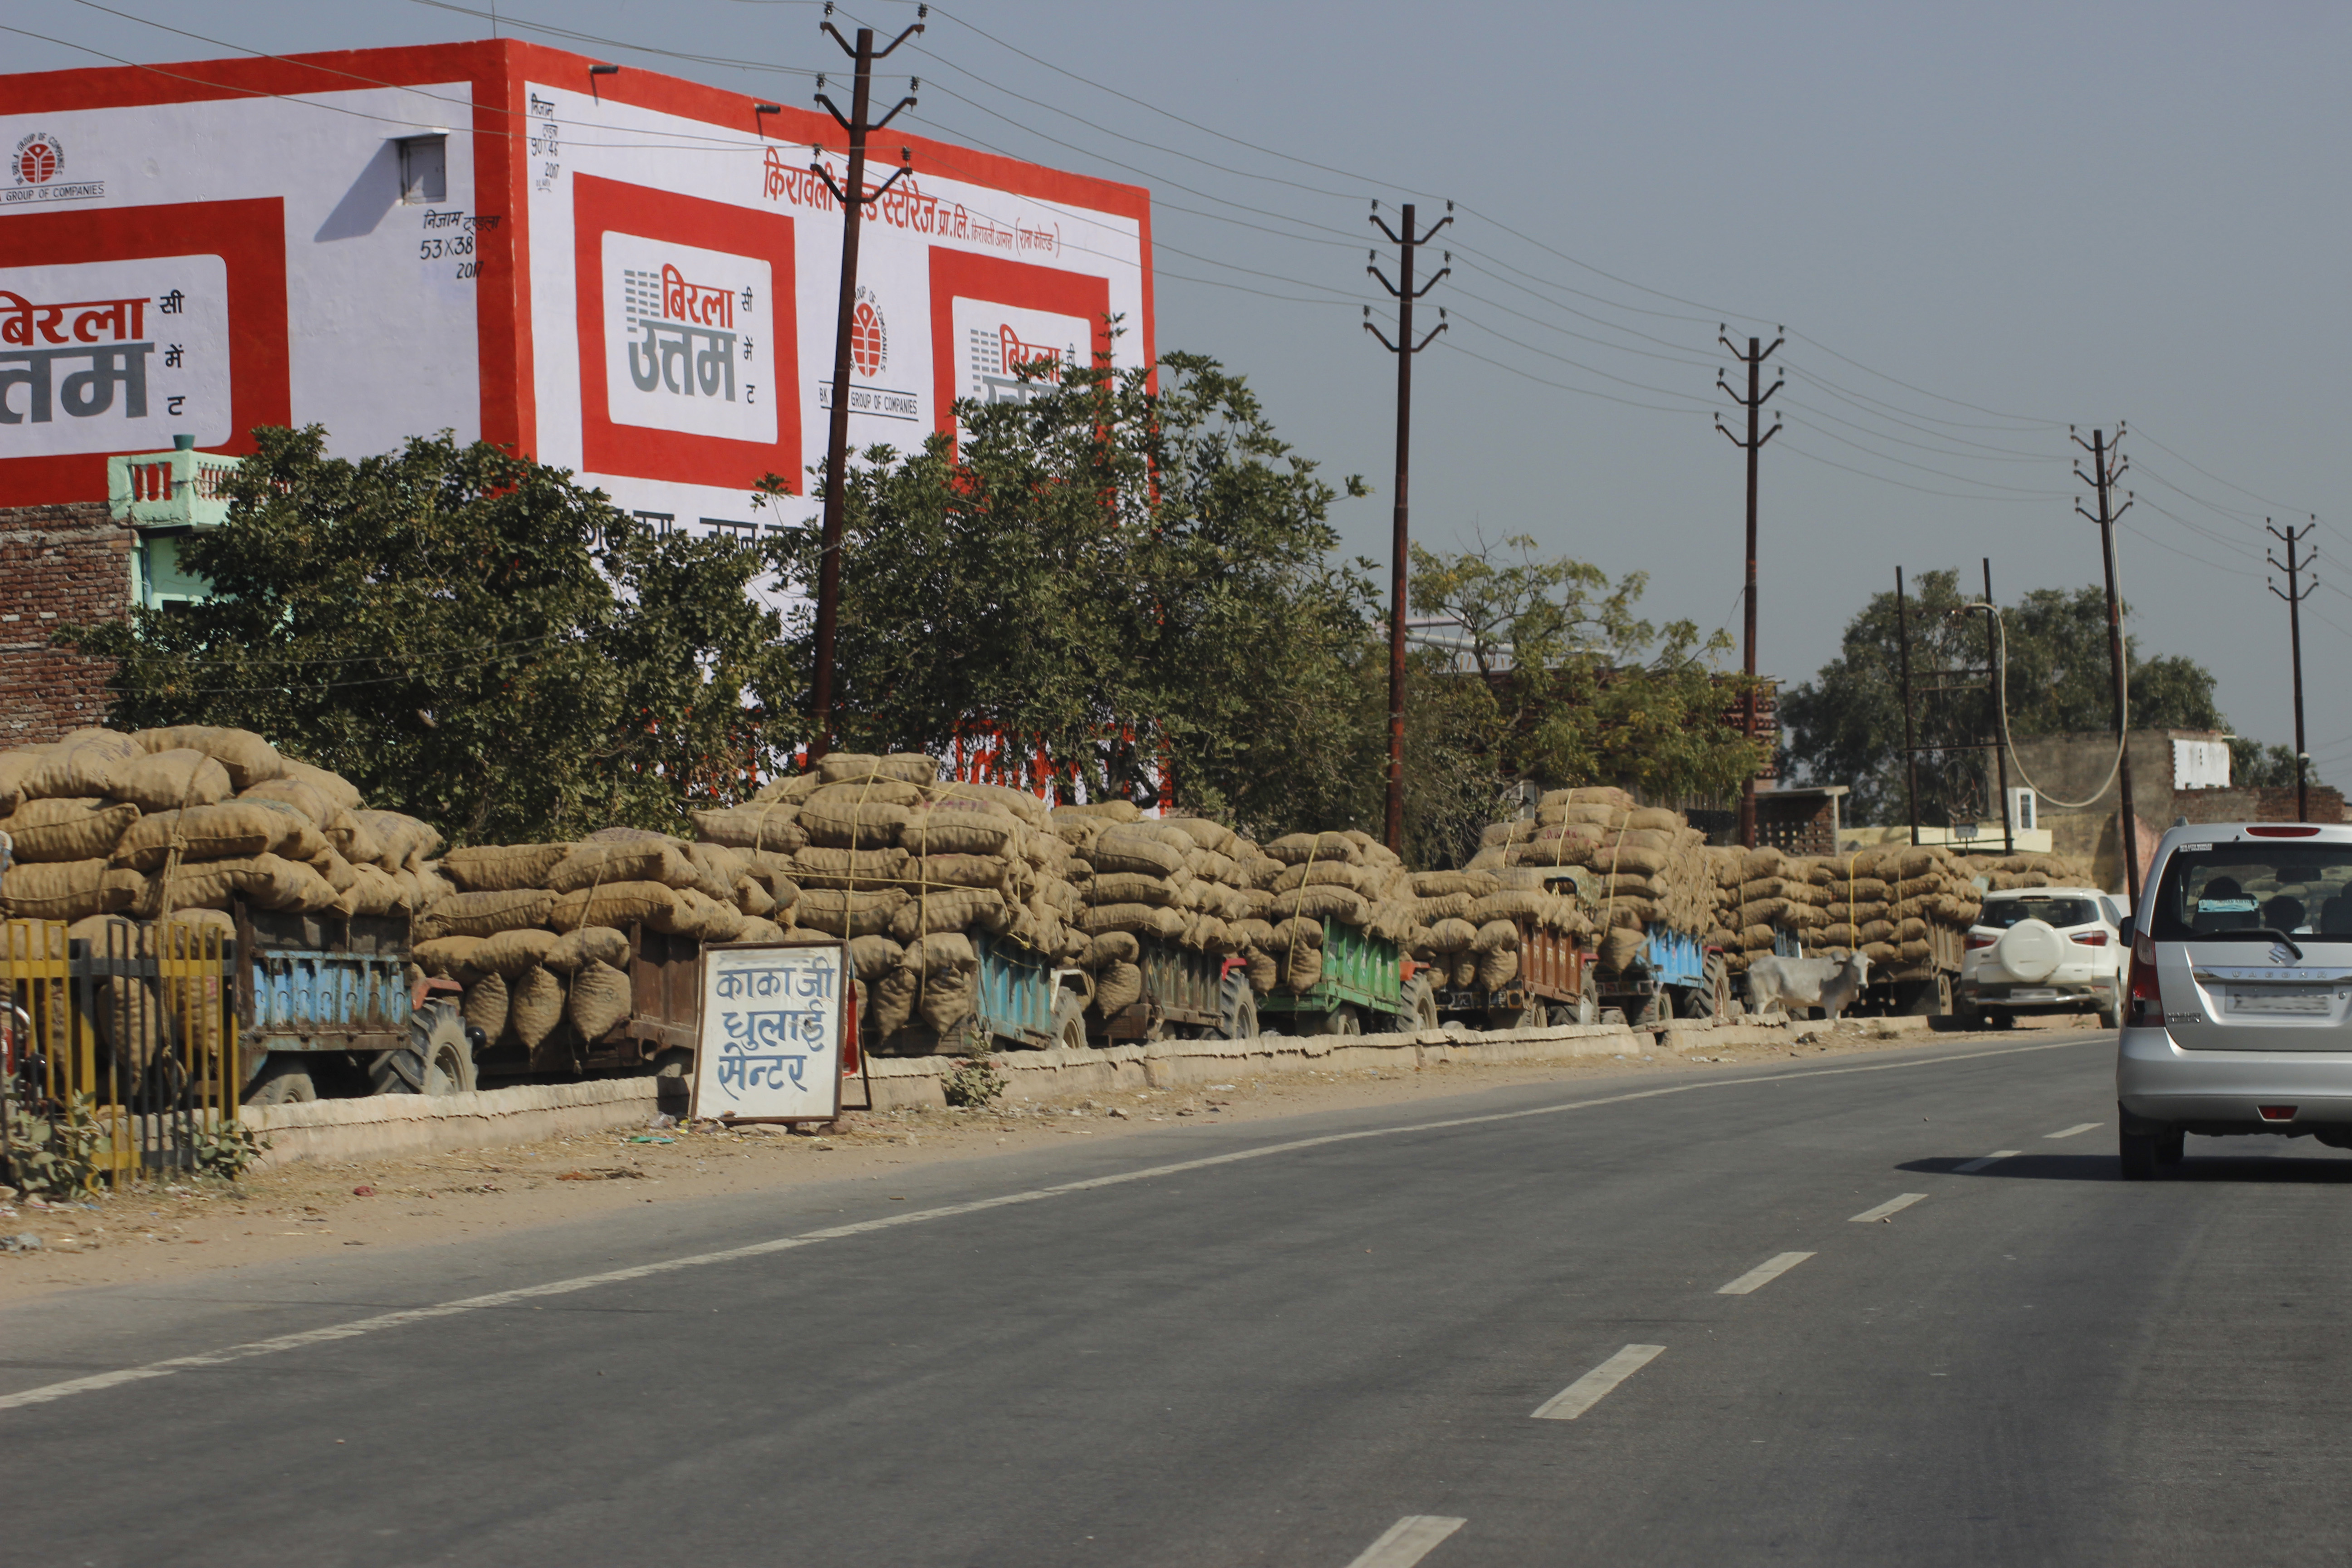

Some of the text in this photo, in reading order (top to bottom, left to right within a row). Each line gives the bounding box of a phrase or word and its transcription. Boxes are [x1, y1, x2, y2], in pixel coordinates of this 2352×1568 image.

[17, 133, 36, 151] GROUP
[6, 184, 105, 201] GROUP OF COMPANIES
[424, 209, 464, 229] निजाम
[456, 261, 485, 279] 2017
[662, 263, 735, 329] बिरला
[628, 318, 737, 402] उत्तम
[851, 392, 871, 407] GROUP
[874, 395, 881, 409] OF
[884, 397, 917, 415] COMPANIES
[717, 1042, 808, 1101] सेन्टर
